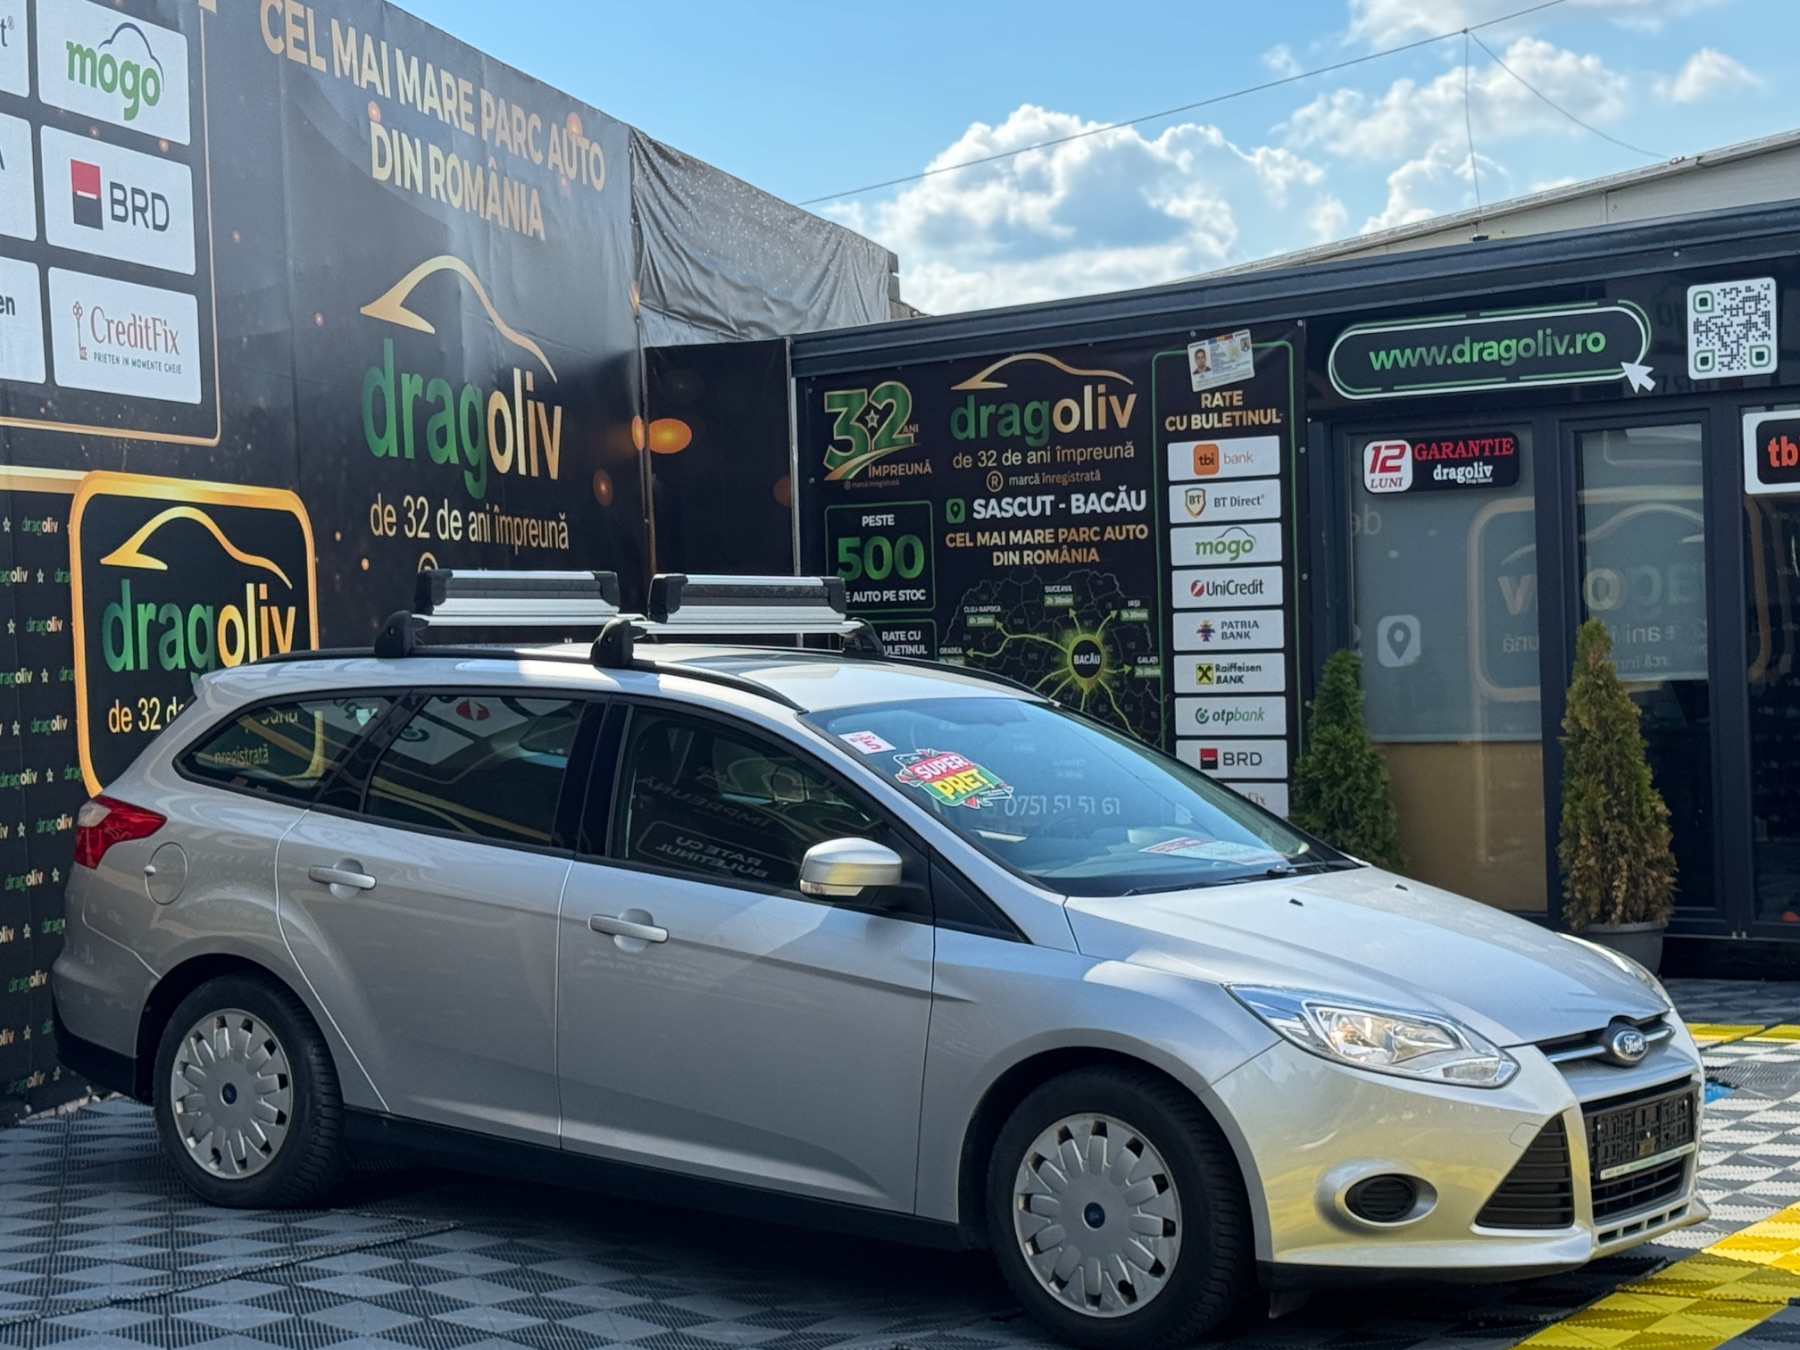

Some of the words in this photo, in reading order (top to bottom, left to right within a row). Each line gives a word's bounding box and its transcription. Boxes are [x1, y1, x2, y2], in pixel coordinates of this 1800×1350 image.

[66, 40, 161, 121] mogo
[260, 0, 327, 73] CEL
[331, 18, 391, 99] MAI
[395, 48, 475, 137] MARE
[480, 88, 544, 165] PARC
[548, 122, 606, 191] AUTO
[370, 121, 423, 195] DIN
[429, 143, 545, 241] ROMÂNIA
[110, 181, 170, 232] BRD
[90, 306, 180, 355] CreditFix
[94, 352, 120, 365] PRIETEN
[1369, 328, 1606, 371] www.dragoliv.ro
[1201, 390, 1243, 409] RATE
[362, 338, 562, 499] dragoliv
[823, 381, 912, 471] 32
[951, 384, 1137, 447] dragoliv
[1165, 416, 1187, 432] CU
[1191, 408, 1281, 430] BULETINUL
[953, 453, 972, 469] de
[978, 450, 997, 467] 32
[1002, 448, 1022, 466] de
[1027, 446, 1051, 464] ani
[1056, 441, 1135, 466] împreună
[1198, 453, 1215, 466] tbi
[1223, 451, 1253, 465] bank
[1369, 444, 1406, 474] 12
[1414, 437, 1515, 460] GARANTIE
[1768, 436, 1800, 468] tb
[868, 459, 932, 478] ÎMPREUNĂ
[1009, 473, 1040, 486] marcă
[1042, 469, 1101, 486] înregistrată
[1433, 461, 1493, 483] dragoliv
[1370, 477, 1403, 489] LUNI
[973, 495, 1055, 519] SASCUT
[1071, 485, 1147, 514] BACĂU
[1189, 495, 1202, 506] BT
[1214, 497, 1227, 508] BT
[21, 516, 59, 537] dragoliv
[370, 493, 397, 537] de
[403, 495, 430, 538] 32
[437, 498, 463, 541] de
[468, 504, 491, 543] ani
[494, 504, 569, 555] împreună
[862, 514, 895, 527] PESTE
[946, 533, 974, 548] CEL
[976, 531, 1006, 547] MAI
[1009, 529, 1055, 546] MARE
[1058, 526, 1100, 543] PARC
[1104, 524, 1149, 541] AUTO
[836, 534, 925, 580] 500
[992, 551, 1022, 566] DIN
[1023, 546, 1100, 565] ROMÂNIA
[1195, 539, 1254, 561] mogo
[0, 566, 28, 587] agoliv
[1206, 579, 1264, 596] UniCredit
[852, 590, 881, 603] AUTO
[882, 590, 897, 602] PE
[898, 589, 926, 602] STOC
[26, 615, 63, 636] dragoliv
[102, 578, 297, 684] dragoliv
[882, 631, 906, 641] RATE
[907, 630, 921, 641] CU
[1221, 619, 1260, 630] PATRIA
[1221, 631, 1252, 641] BANK
[883, 644, 928, 655] ULETINUL
[1073, 652, 1100, 665] BACĂU
[0, 667, 33, 688] ragoliv
[1215, 662, 1262, 673] Raiffeisen
[1216, 674, 1244, 685] BANK
[31, 714, 68, 736] dragoliv
[108, 698, 132, 733] de
[138, 697, 161, 731] 32
[166, 696, 184, 723] d
[1212, 707, 1266, 725] otpbank
[915, 755, 969, 780] SUPER
[1223, 752, 1263, 767] BRD
[1004, 794, 1047, 816] 0751
[1101, 796, 1121, 815] 61
[36, 813, 73, 835] dragoliv
[5, 868, 44, 892] dragoliv
[8, 969, 48, 993] dragoliv
[1624, 1034, 1645, 1054] Ford
